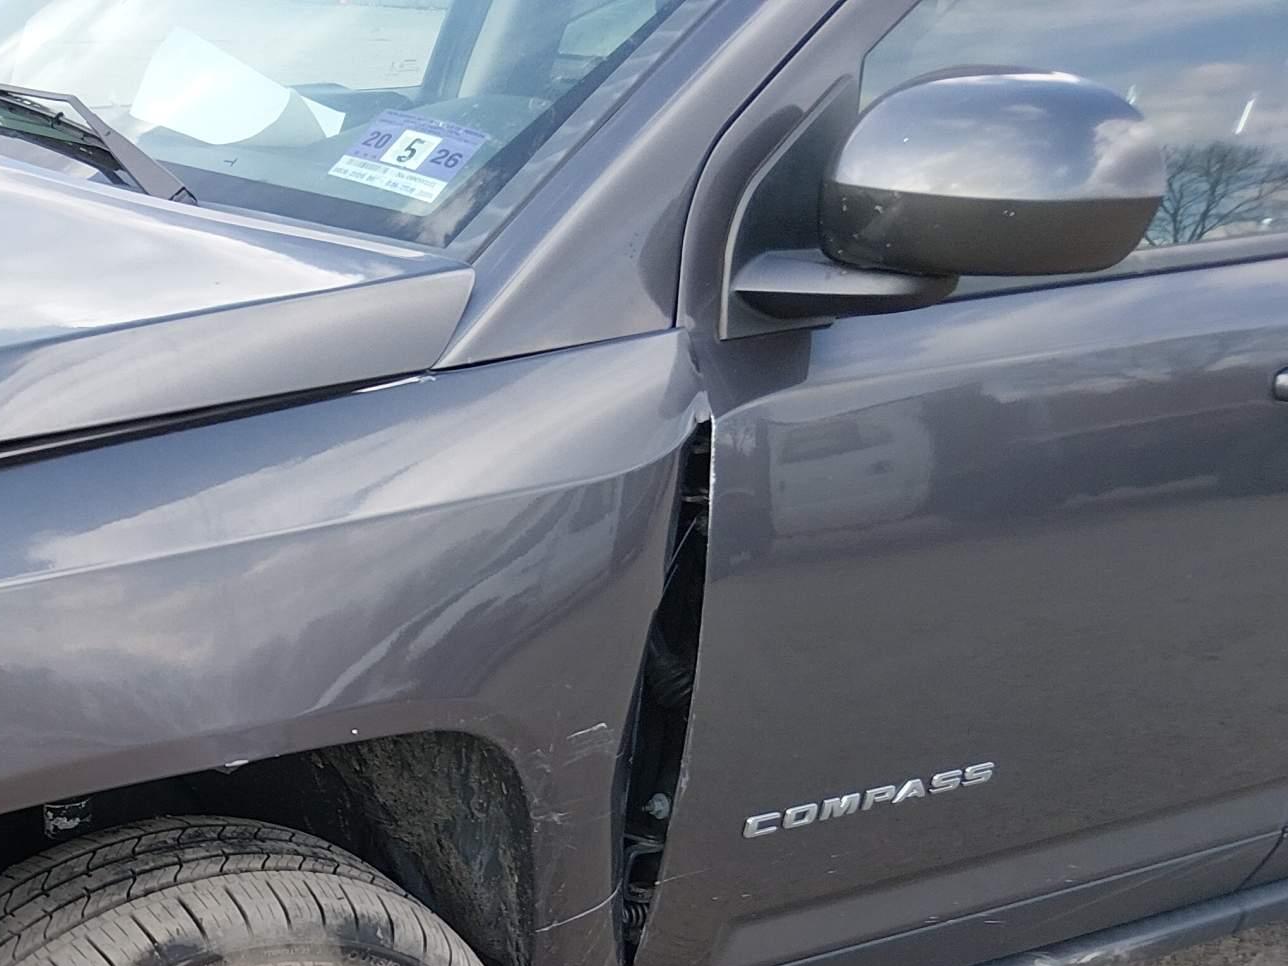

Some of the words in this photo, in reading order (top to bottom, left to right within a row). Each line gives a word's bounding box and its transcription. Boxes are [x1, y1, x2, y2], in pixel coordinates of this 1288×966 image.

[361, 131, 393, 149] 20
[396, 138, 424, 162] 5
[429, 148, 463, 169] 26
[743, 761, 995, 838] COMPASS
